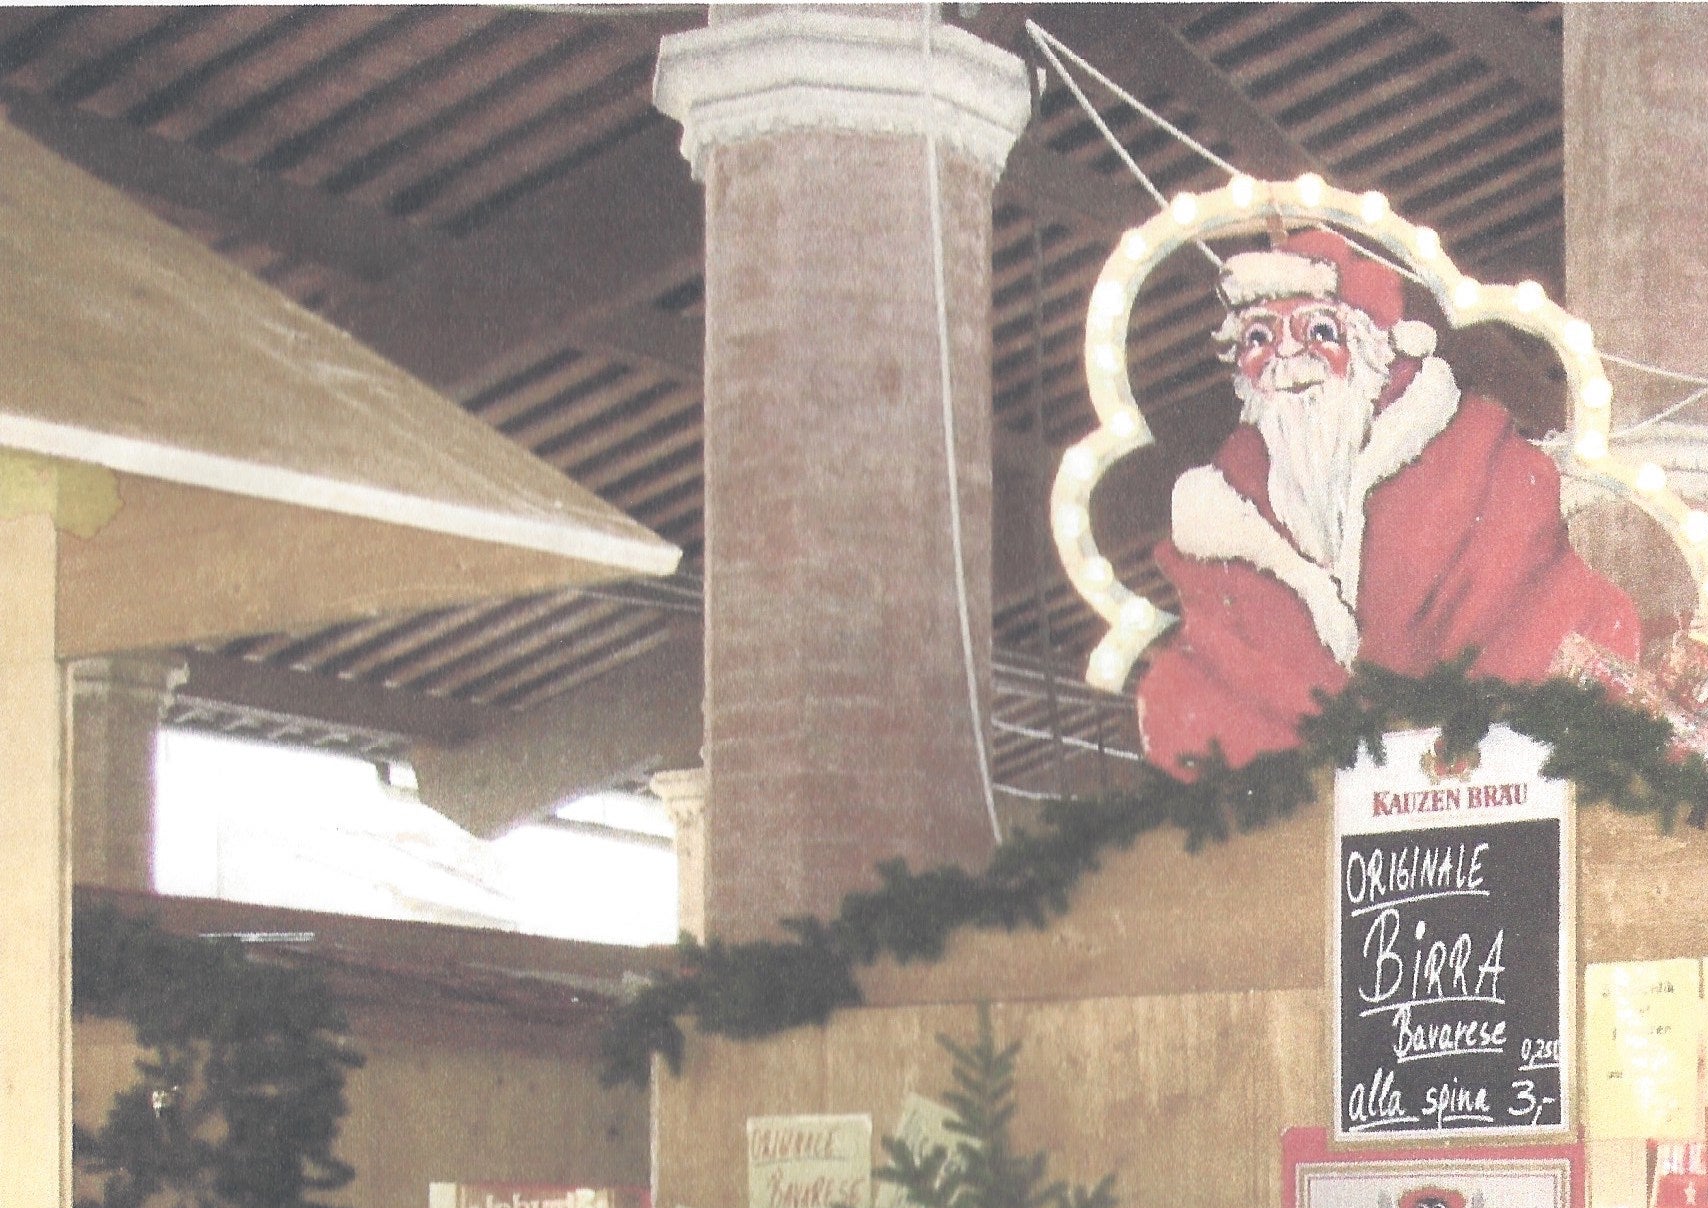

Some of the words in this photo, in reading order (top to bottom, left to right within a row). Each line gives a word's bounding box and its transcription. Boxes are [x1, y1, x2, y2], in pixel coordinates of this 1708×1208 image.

[1372, 785, 1462, 817] KAUZEN
[1466, 782, 1529, 809] BRÄU
[1346, 841, 1490, 904] ORIGINALE
[1391, 1007, 1507, 1058] Bavarese
[1347, 1066, 1408, 1123] alla
